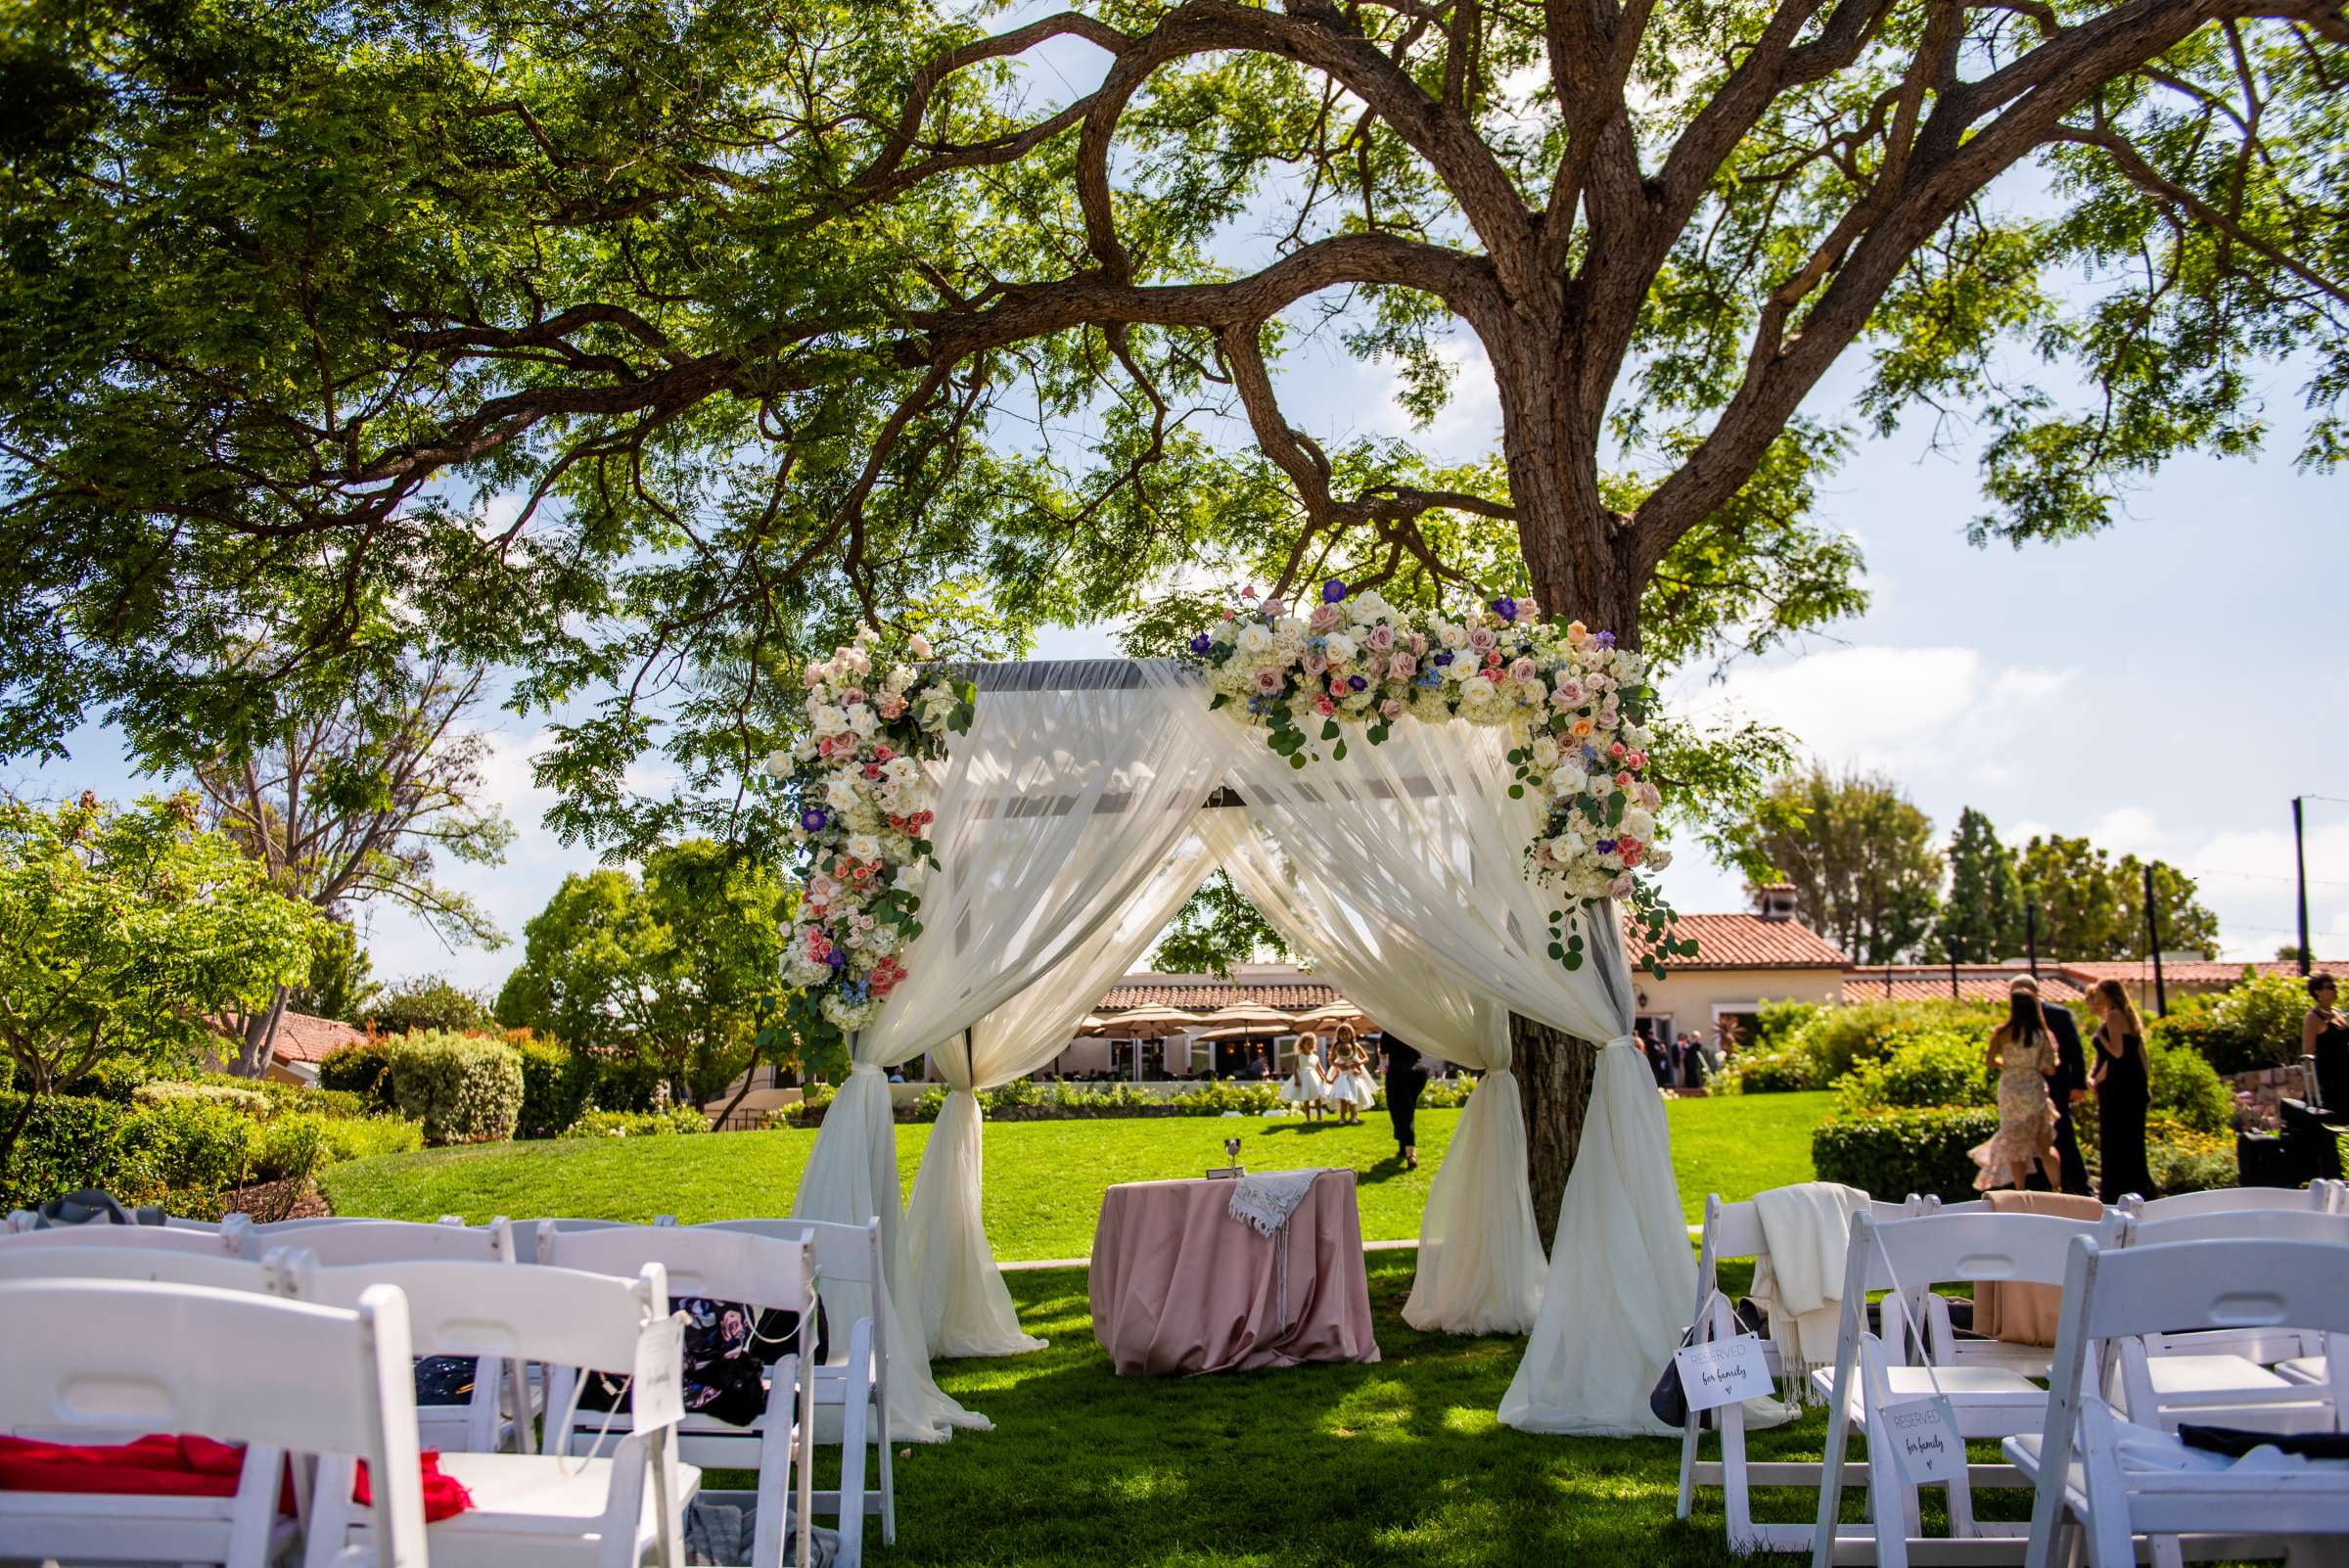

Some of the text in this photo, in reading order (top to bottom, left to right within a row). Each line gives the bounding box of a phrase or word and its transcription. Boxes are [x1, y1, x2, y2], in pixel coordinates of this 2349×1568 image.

[1690, 1345, 1746, 1365] RESERVED
[1702, 1364, 1746, 1386] for family
[1893, 1409, 1942, 1429] RESERVED
[1906, 1434, 1944, 1455] for family
